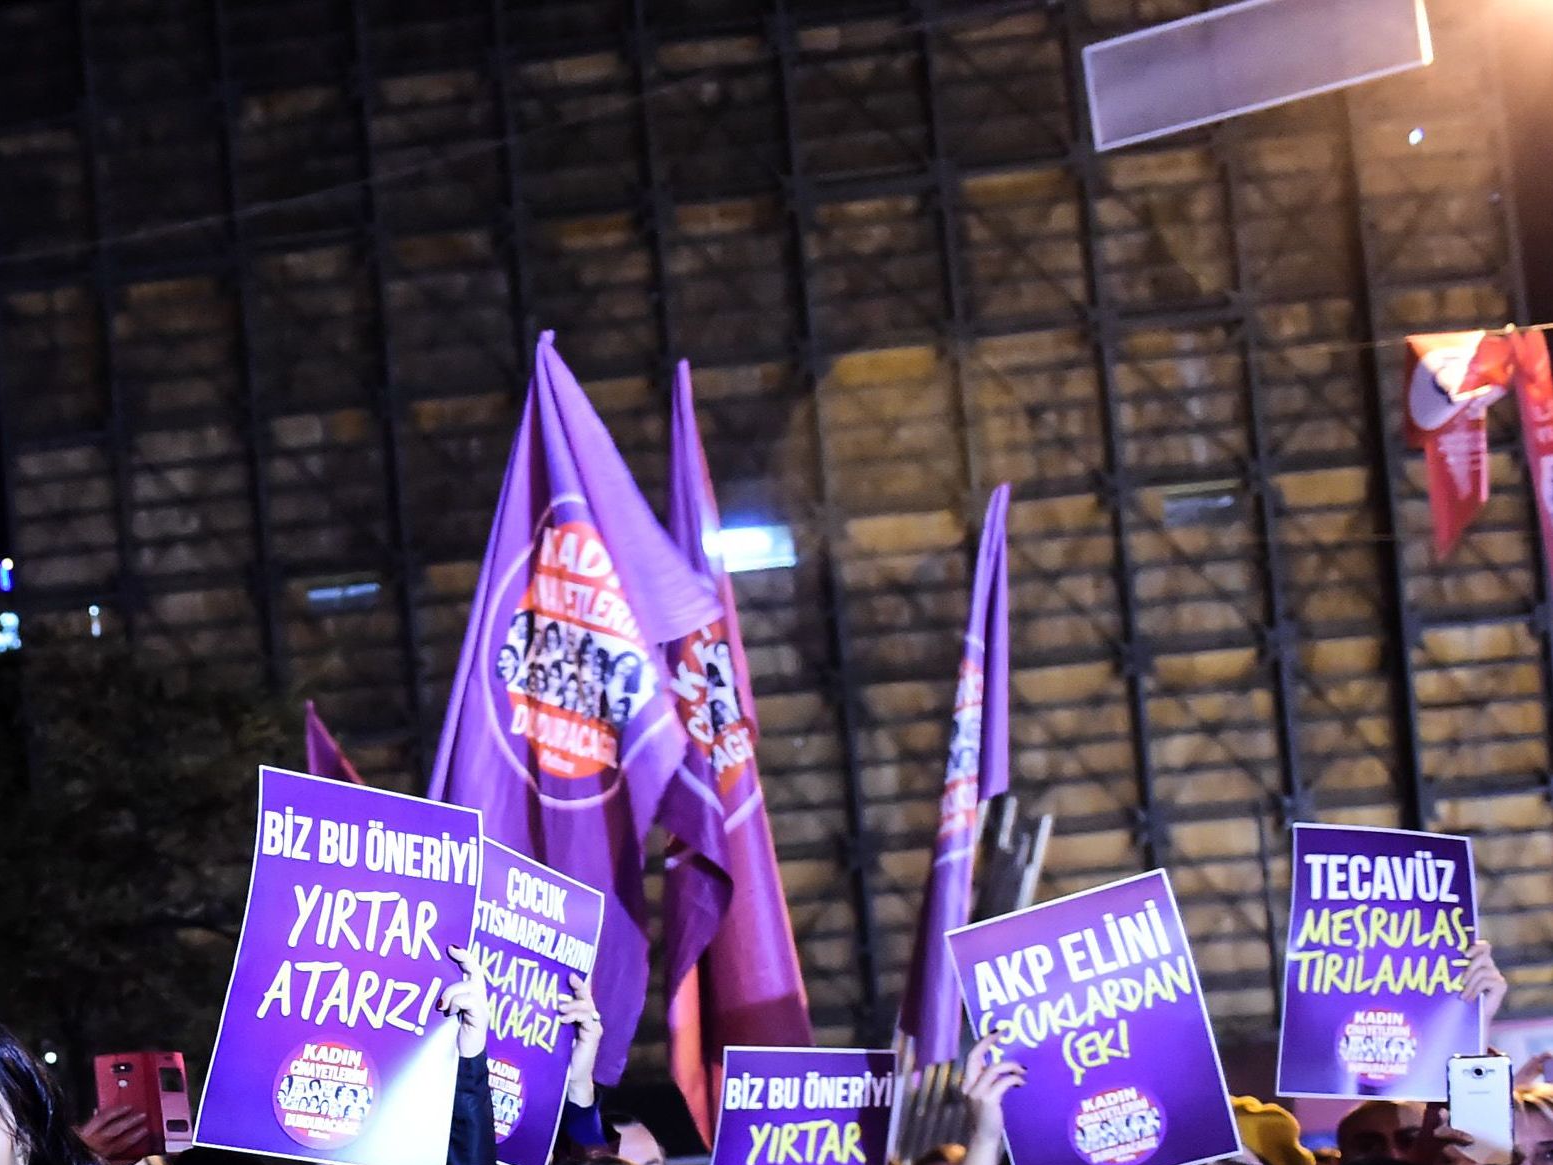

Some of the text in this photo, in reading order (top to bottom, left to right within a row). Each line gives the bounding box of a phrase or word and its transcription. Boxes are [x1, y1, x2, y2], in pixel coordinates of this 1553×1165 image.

[261, 806, 478, 887] BİZ BU ÖNERİYİ
[1303, 850, 1460, 903] TECAVÜZ
[287, 884, 442, 961] YIRTAR
[506, 867, 568, 924] ÇOCUK
[974, 899, 1172, 1012] AKP ELİNİ
[256, 960, 443, 1037] ATARIZ!
[302, 1043, 363, 1068] KADIN
[1061, 1018, 1131, 1086] ÇEK!
[724, 1071, 893, 1110] BİZ BU ÖNERİYİ
